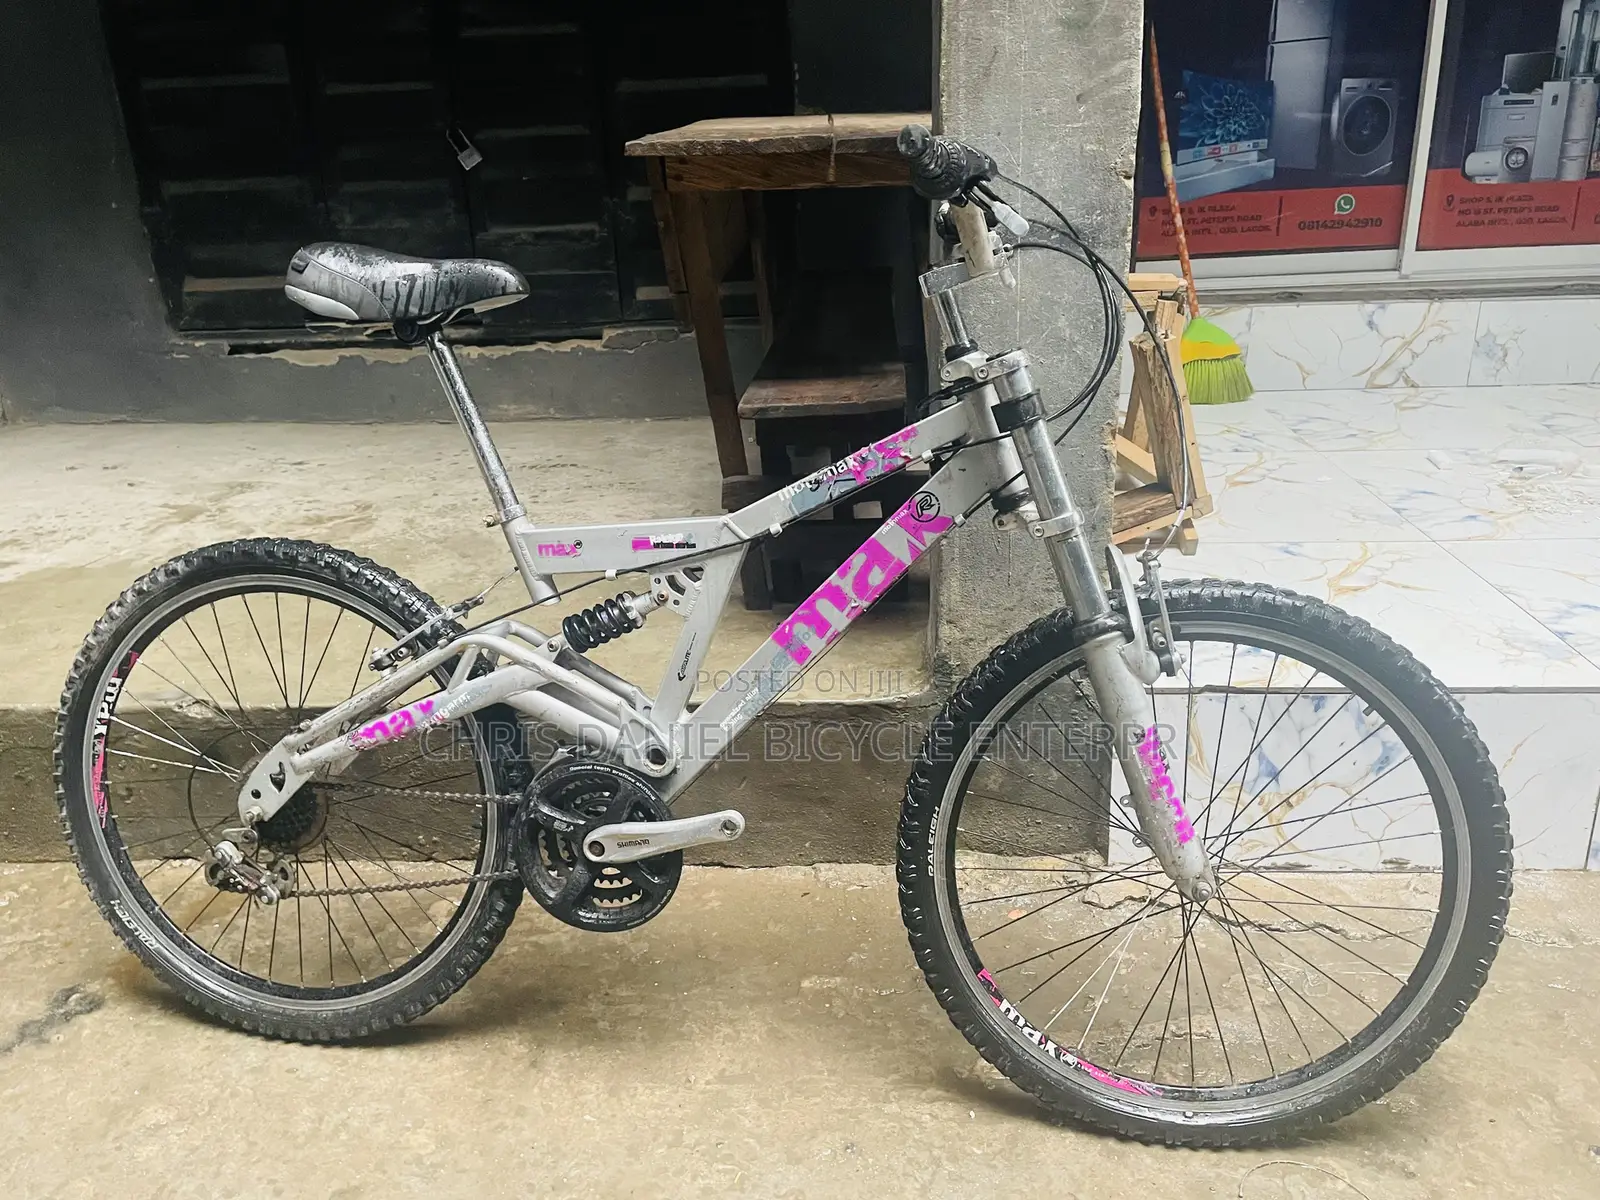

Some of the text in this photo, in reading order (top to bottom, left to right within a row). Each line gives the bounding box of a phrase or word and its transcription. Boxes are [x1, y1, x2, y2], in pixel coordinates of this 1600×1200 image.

[1459, 196, 1484, 205] SHOP
[1534, 204, 1560, 213] ROAD
[1236, 214, 1262, 222] ROAD
[616, 838, 650, 849] SHIMANO
[927, 806, 940, 877] RALEIGH
[110, 899, 160, 950] RALEIGH
